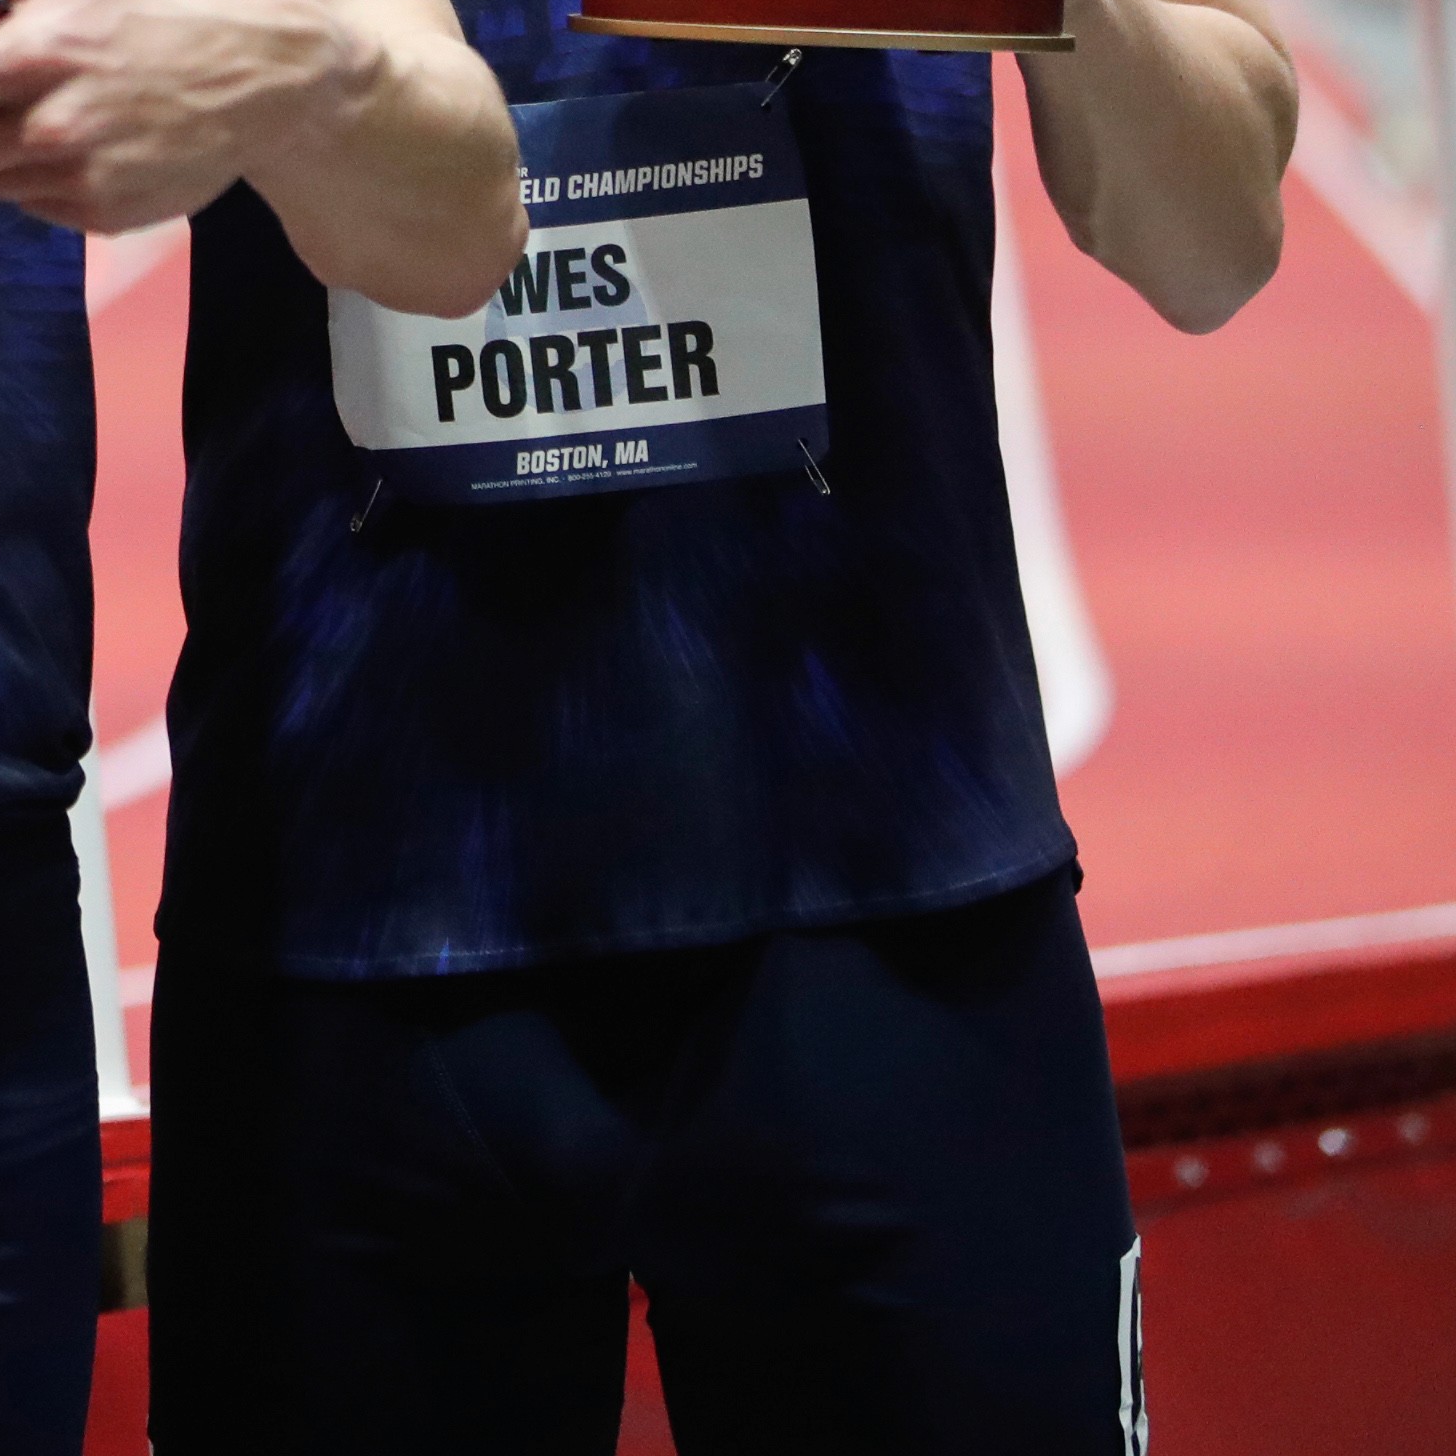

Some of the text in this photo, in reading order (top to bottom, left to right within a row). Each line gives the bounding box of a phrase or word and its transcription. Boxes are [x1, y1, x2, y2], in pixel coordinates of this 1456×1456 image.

[520, 154, 764, 205] ELD CHAMPIONSHIPS
[499, 244, 631, 317] WES
[431, 319, 720, 423] PORTER
[516, 440, 649, 475] BOSTON, MA
